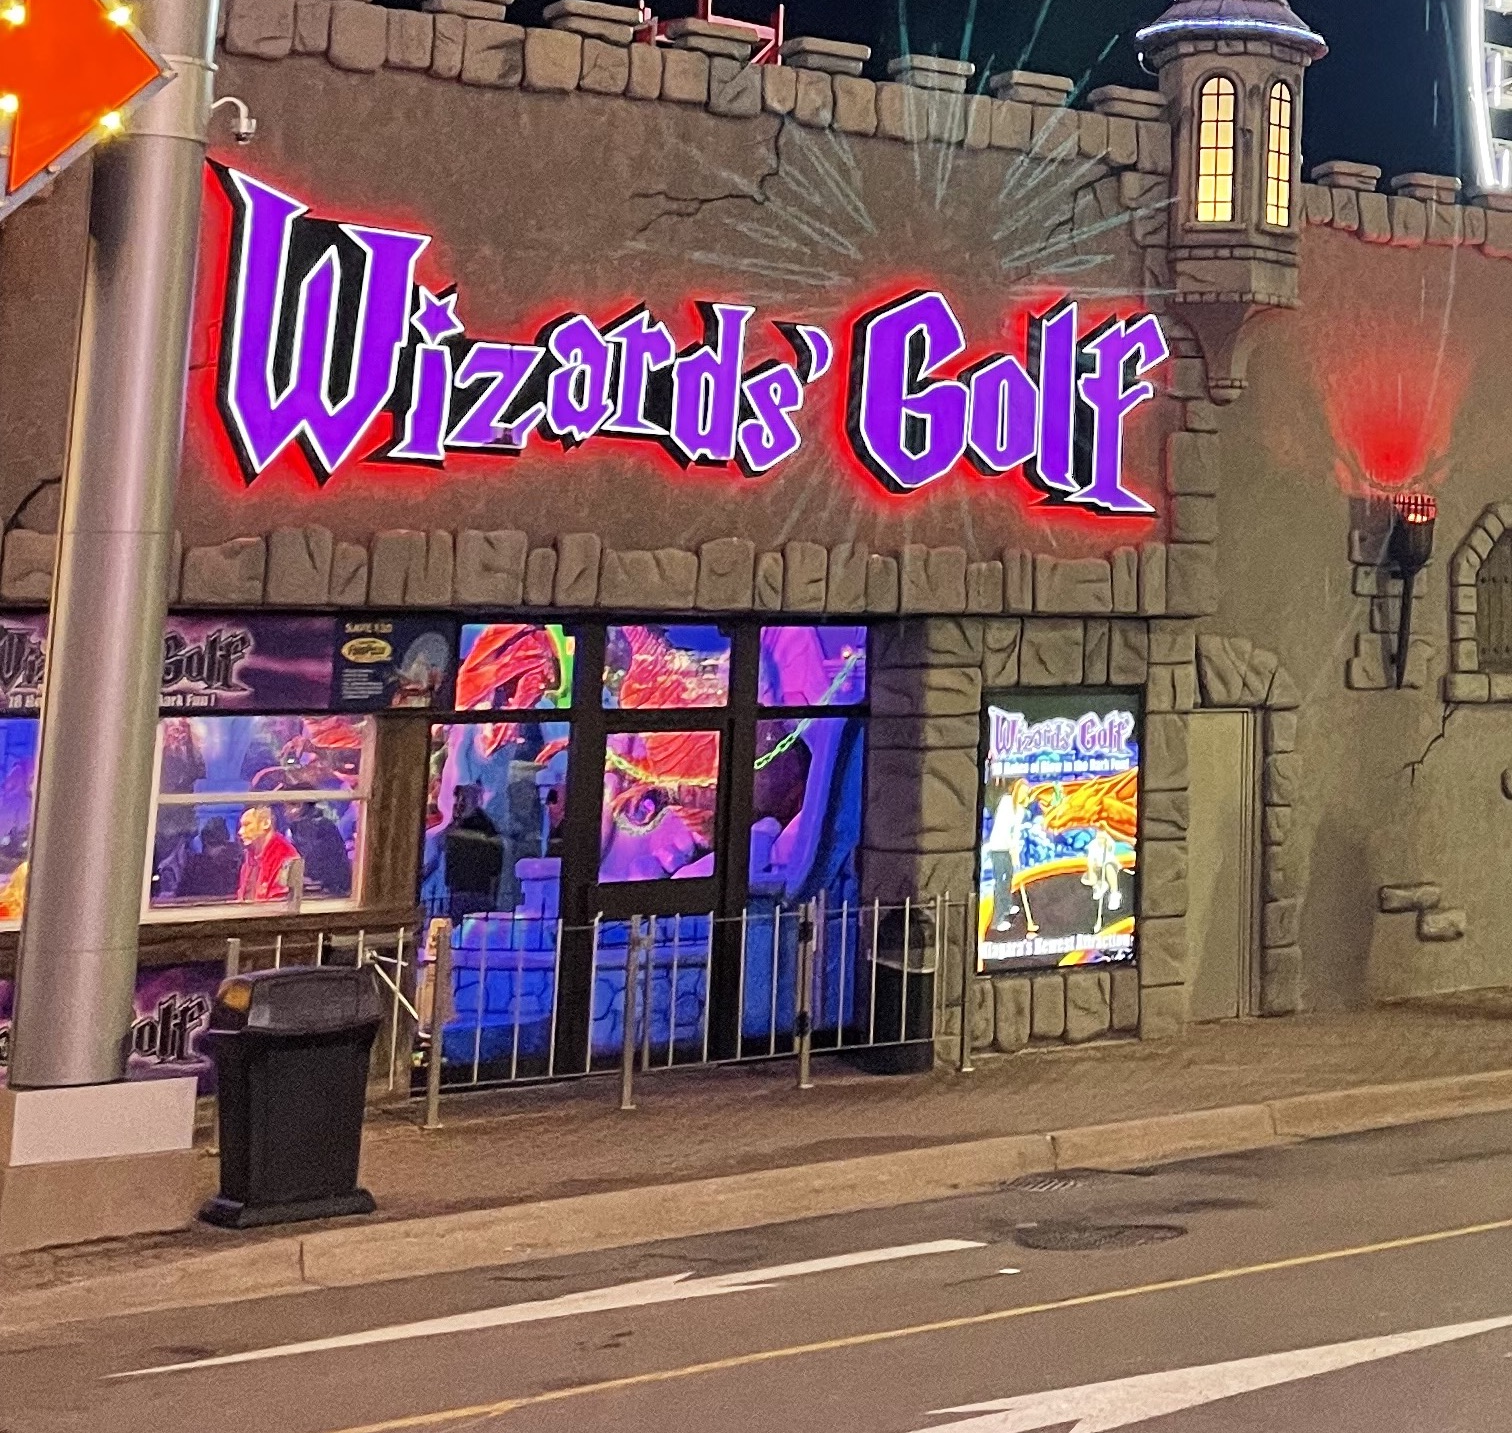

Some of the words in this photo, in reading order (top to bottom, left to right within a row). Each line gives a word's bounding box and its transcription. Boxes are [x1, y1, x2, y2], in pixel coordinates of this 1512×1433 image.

[214, 161, 834, 480] Wizards'
[850, 289, 1172, 516] Golf
[1078, 711, 1134, 754] Golf
